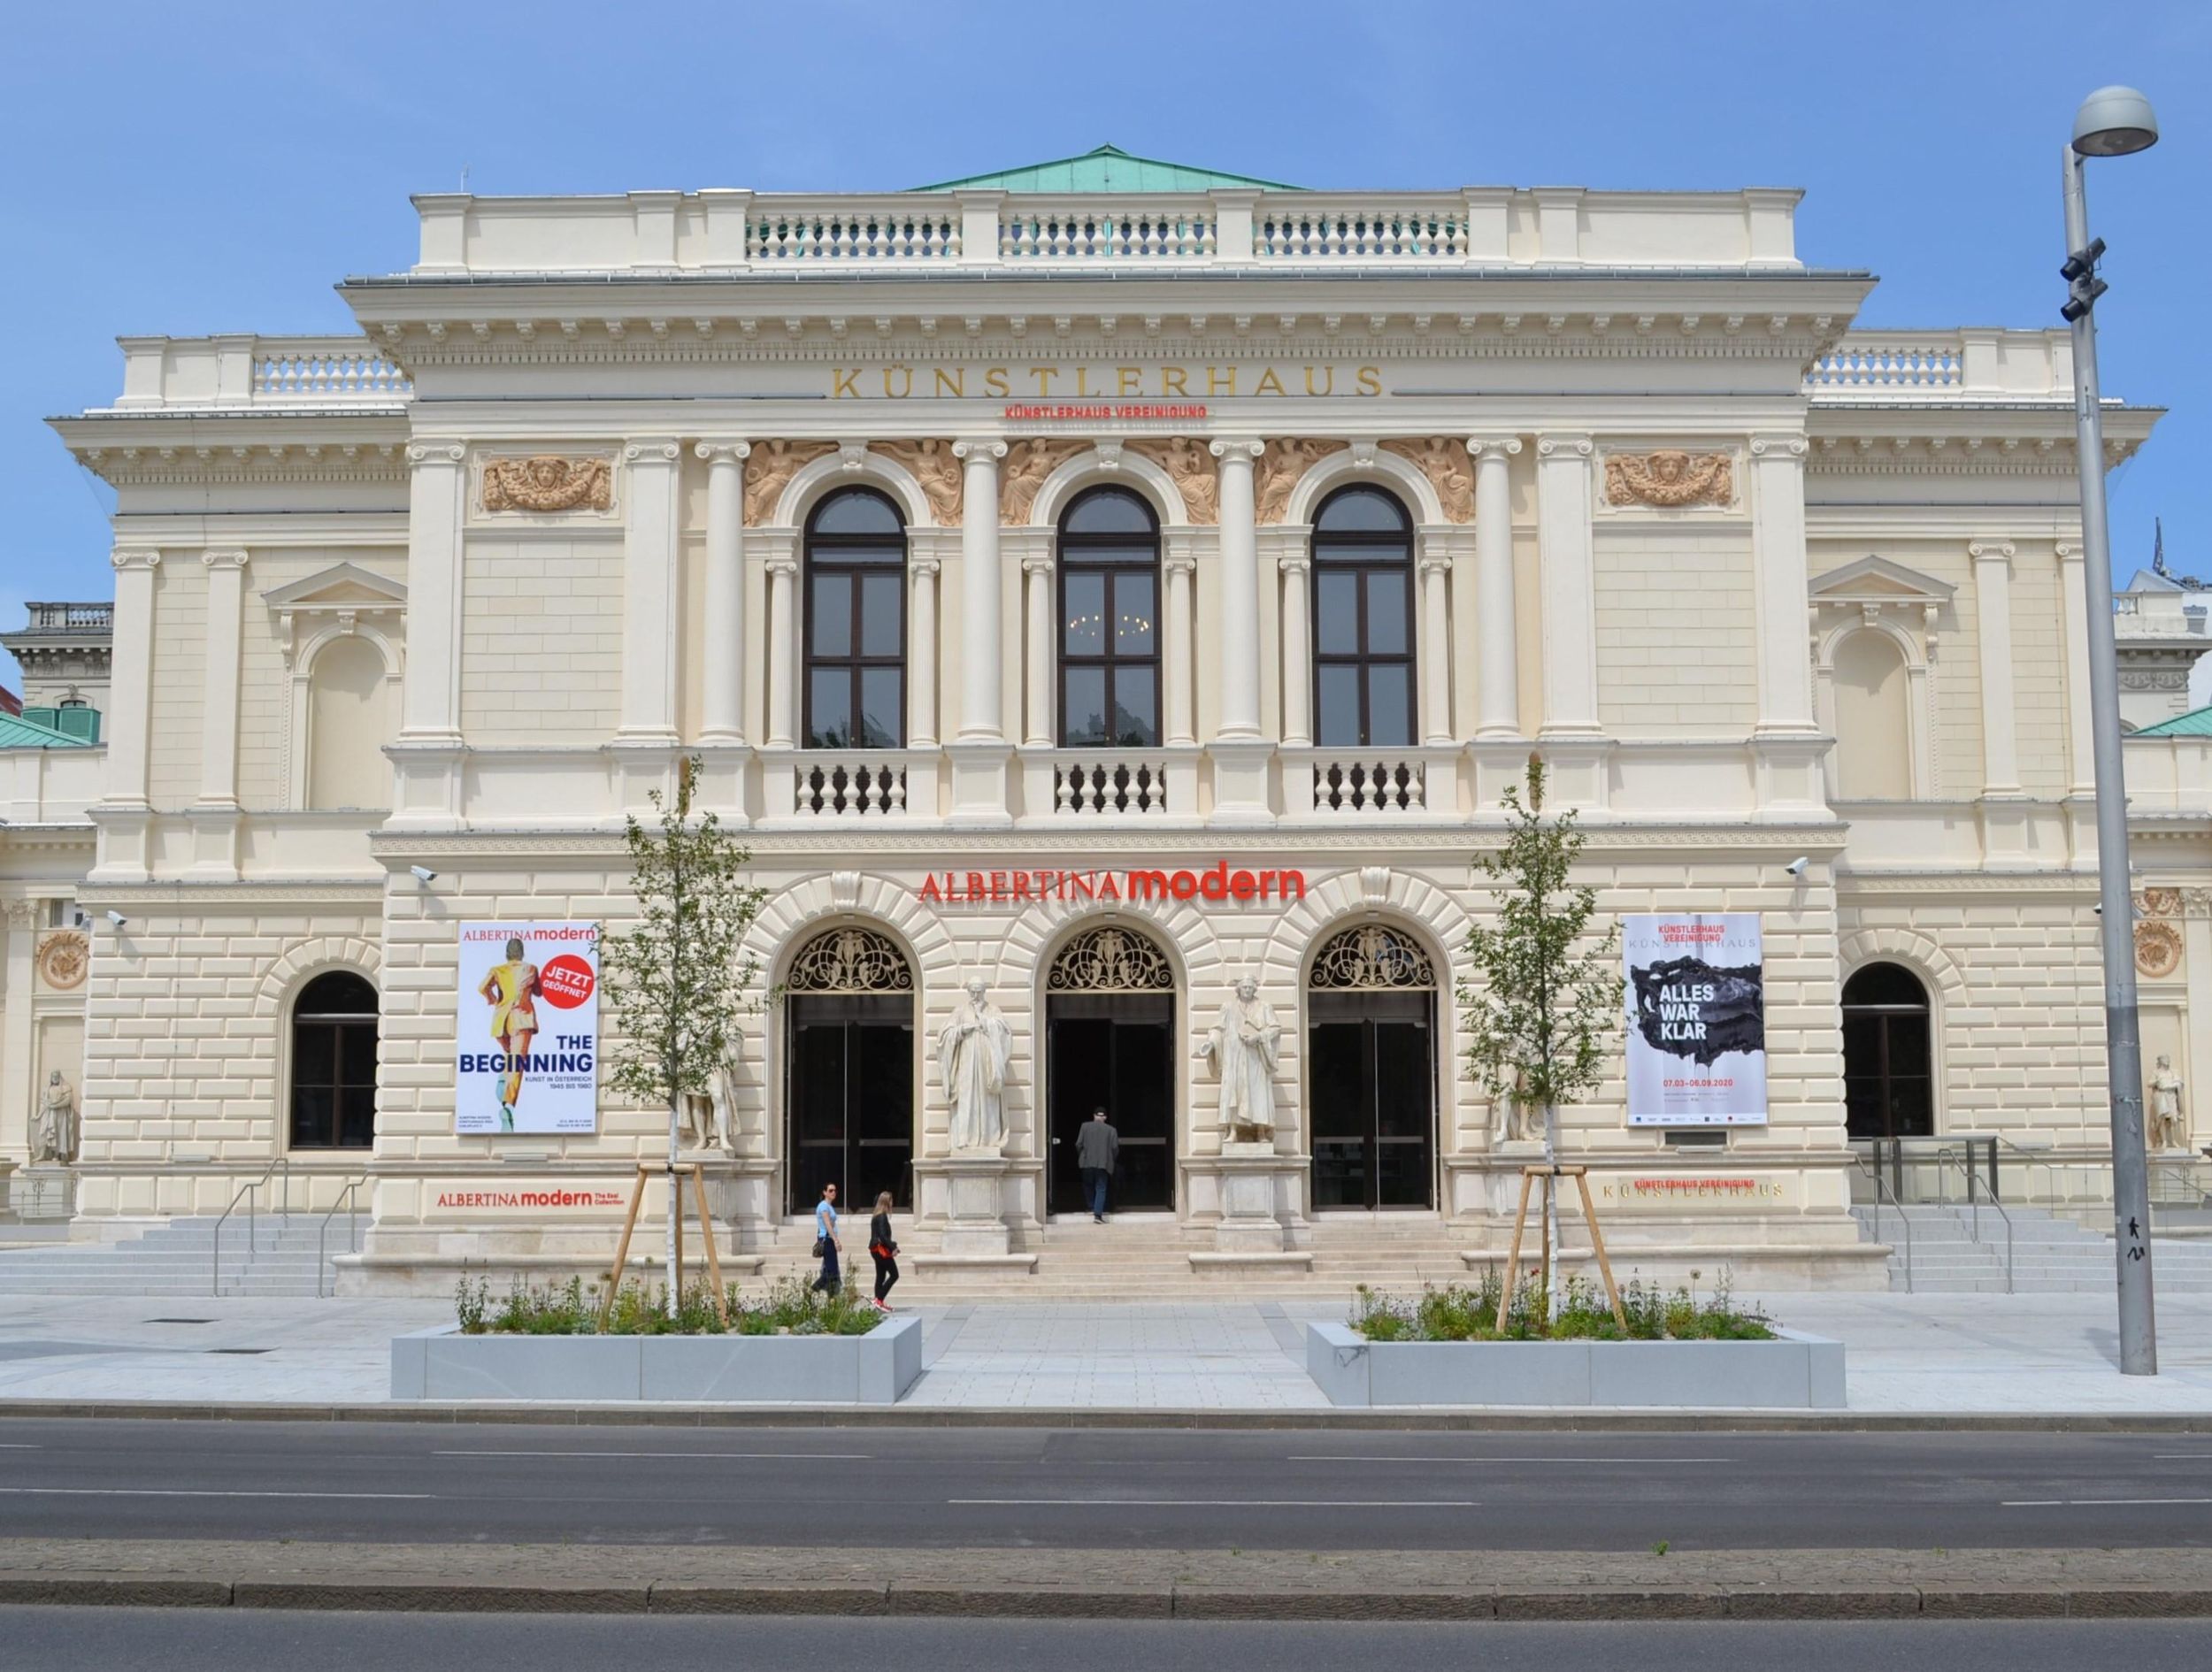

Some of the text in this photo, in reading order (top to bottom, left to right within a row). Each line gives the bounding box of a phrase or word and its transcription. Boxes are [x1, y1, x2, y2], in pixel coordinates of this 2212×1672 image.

[833, 364, 1381, 398] KÜNSTLERHAUS
[1005, 404, 1207, 419] KÜNSTLERHAUS VEREINIGUNG
[918, 860, 1305, 902] ALBERTINA modern
[464, 927, 595, 941] ALBERTINA modern
[1658, 924, 1724, 934] KÜNSTLERHAUS
[1663, 934, 1721, 943] VEREINIGUNG
[546, 965, 592, 988] JETZT
[542, 978, 587, 999] GEÖFFNET
[1659, 985, 1715, 1002] ALLES
[1659, 1004, 1700, 1021] WAR
[1661, 1023, 1707, 1040] KLAR
[556, 1035, 593, 1049] THE
[459, 1054, 593, 1073] BEGINNING
[1634, 1179, 1755, 1189] KÜNSTLERHAUS VEREINIGUNG
[437, 1189, 592, 1207] ALBERTINA modern
